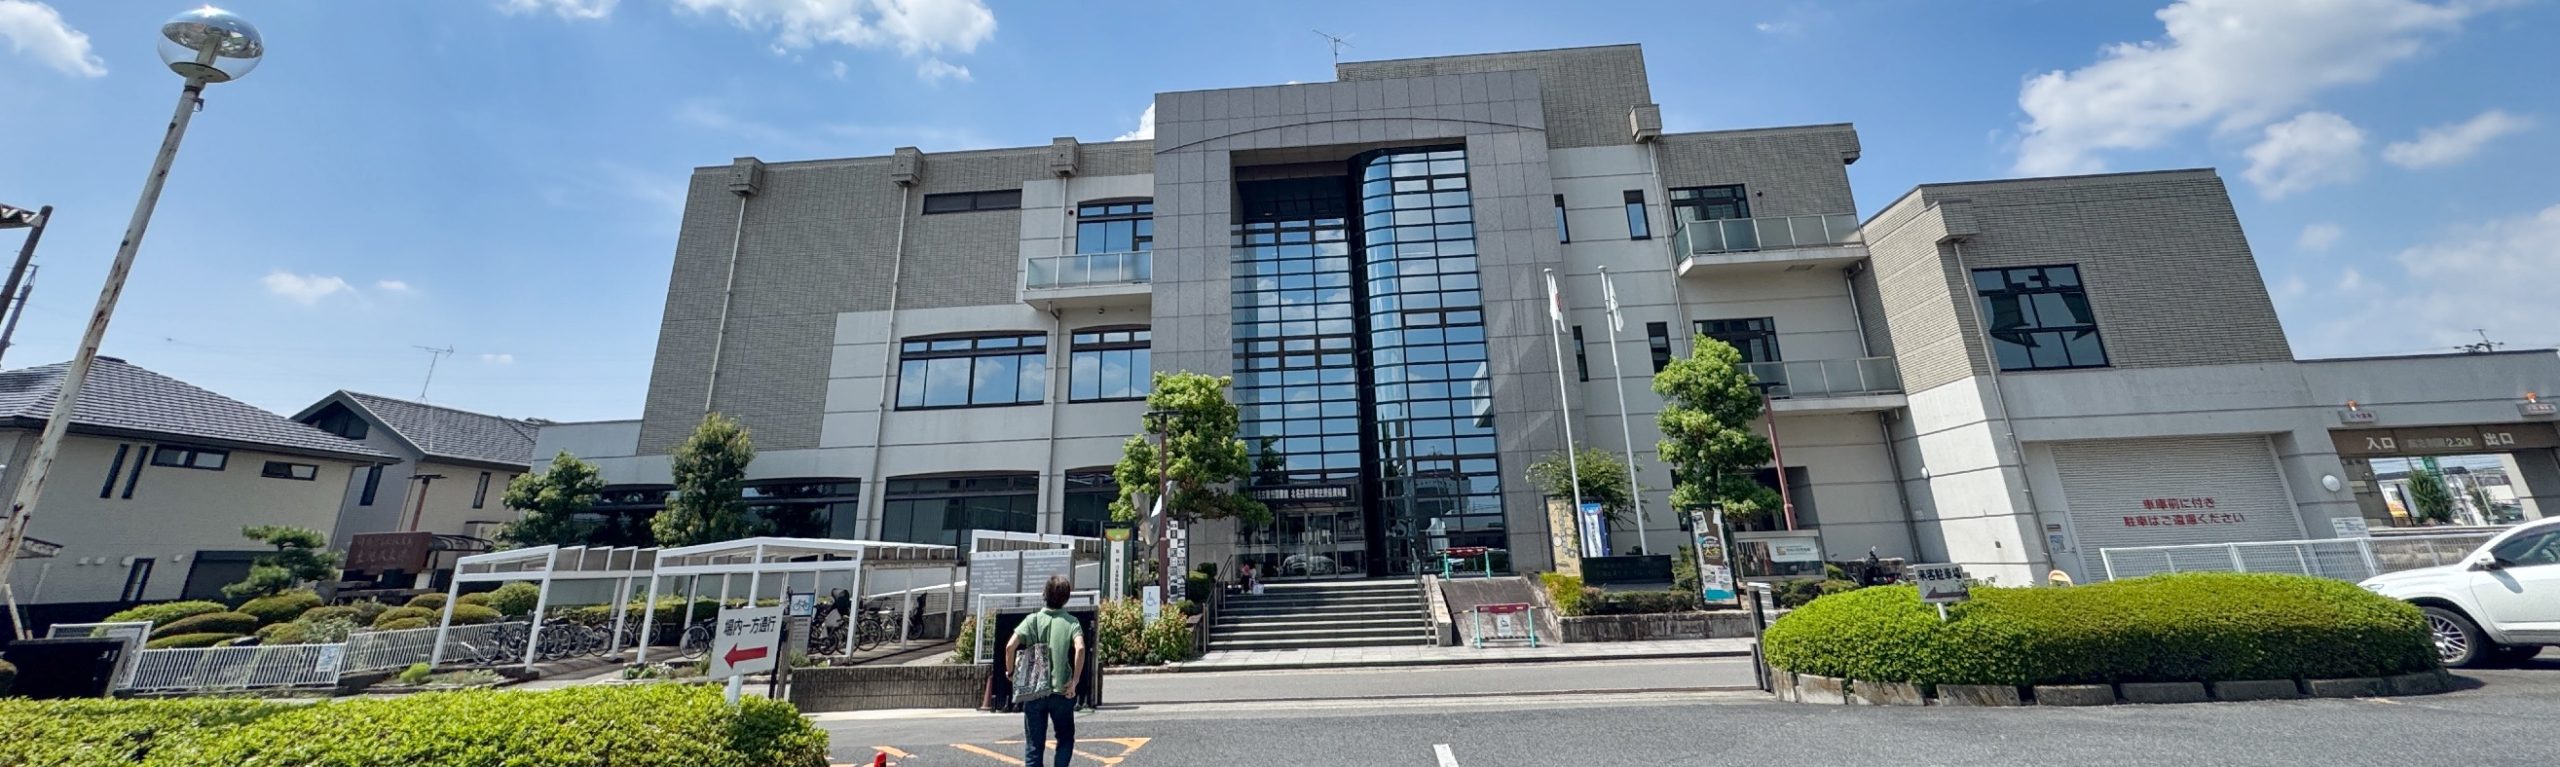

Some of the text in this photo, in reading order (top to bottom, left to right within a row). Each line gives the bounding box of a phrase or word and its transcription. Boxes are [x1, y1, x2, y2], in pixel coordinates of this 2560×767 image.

[2366, 436, 2395, 450] 入口
[2484, 432, 2514, 446] 出口
[2143, 497, 2215, 510] 車庫前に付き
[2123, 512, 2246, 527] 駐車はご遠慮ください
